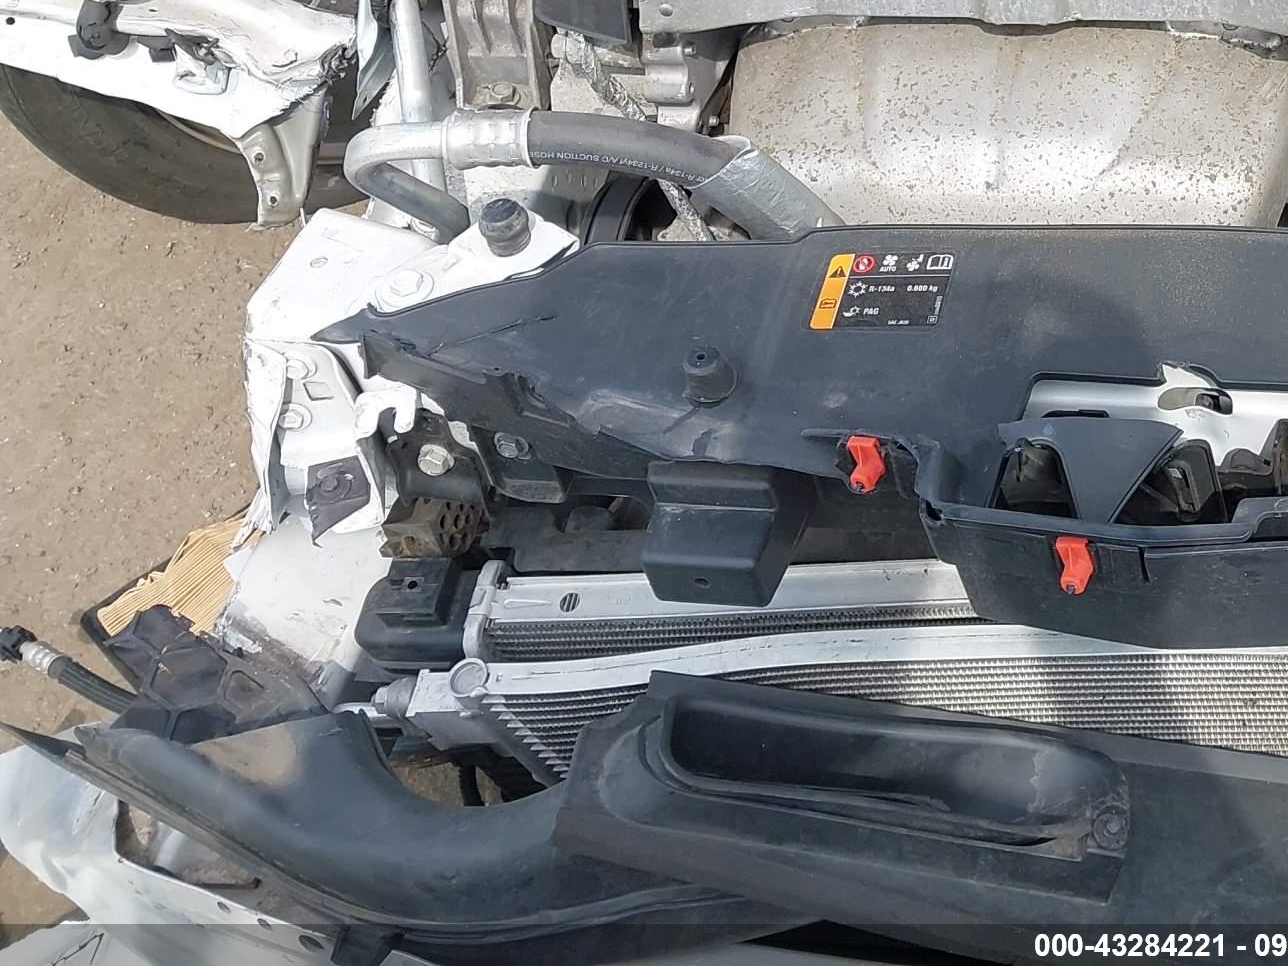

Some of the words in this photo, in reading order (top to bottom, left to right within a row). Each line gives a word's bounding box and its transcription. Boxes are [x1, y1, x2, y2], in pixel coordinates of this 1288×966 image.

[556, 151, 600, 162] SUCTION
[602, 155, 618, 165] A/C
[863, 307, 880, 315] PAG
